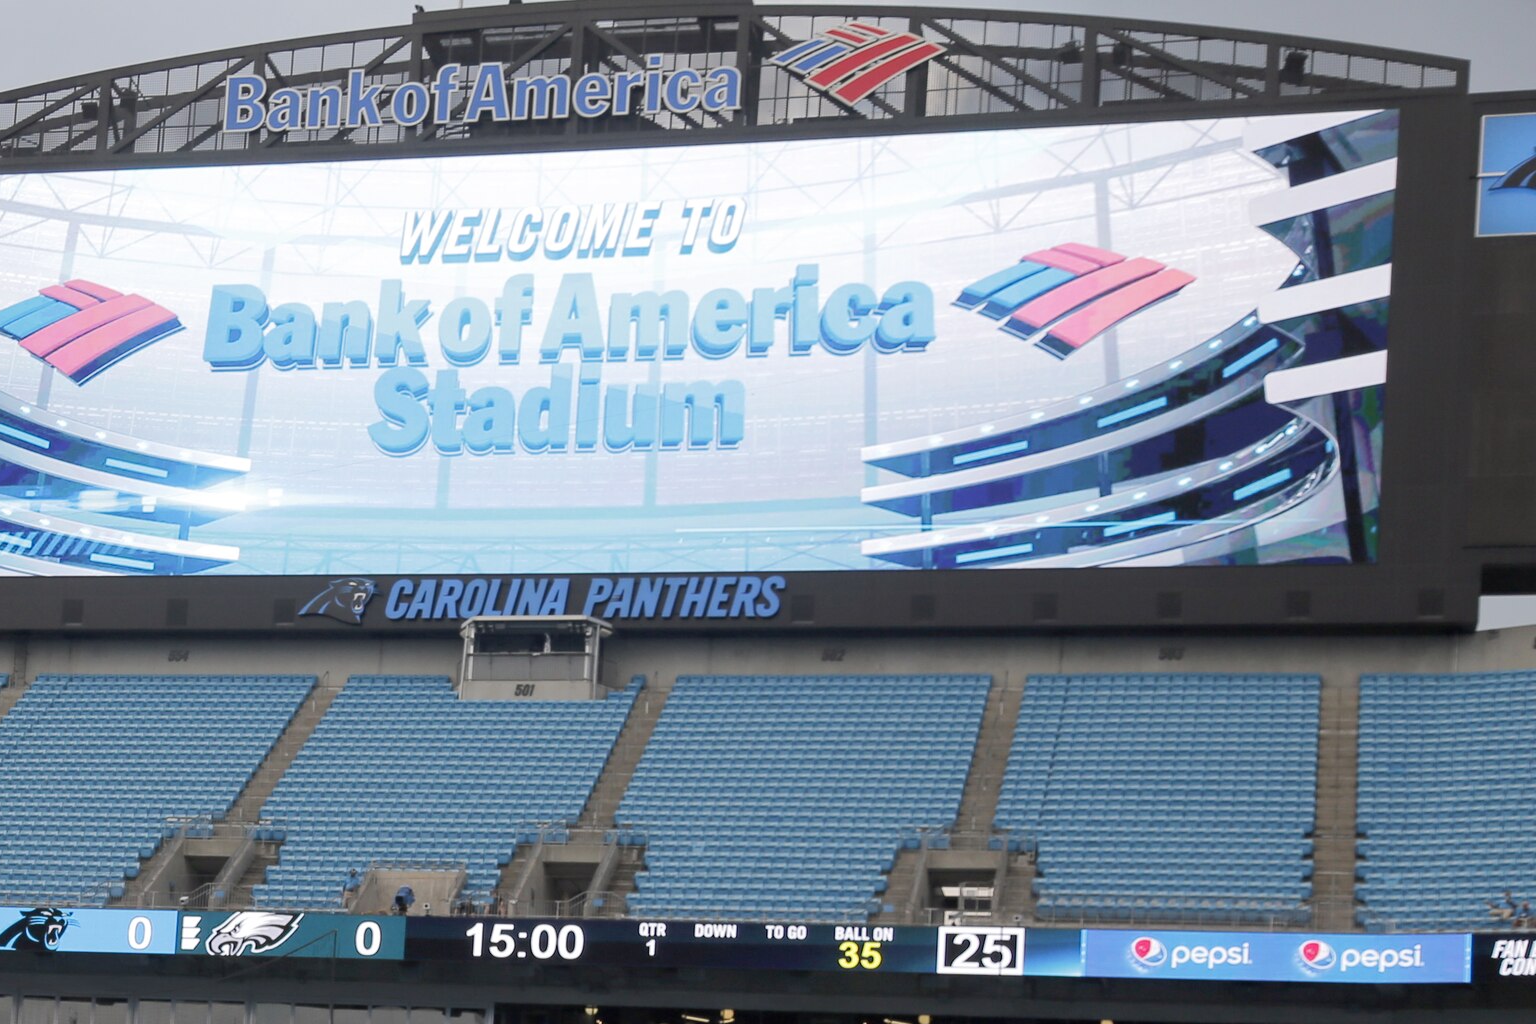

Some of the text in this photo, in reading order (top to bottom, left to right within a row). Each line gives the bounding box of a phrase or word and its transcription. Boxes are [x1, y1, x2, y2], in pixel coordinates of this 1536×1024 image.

[222, 54, 743, 134] Bank of America
[399, 196, 748, 265] WELCOME TO
[202, 262, 936, 372] Bank of America
[367, 362, 747, 458] Stadium
[383, 575, 788, 621] CAROLINA PANTHERS
[514, 684, 535, 697] 501
[127, 917, 153, 950] 0
[354, 922, 381, 957] 0
[465, 922, 585, 960] 15:00
[638, 922, 894, 942] QTR DOWN TO GO BALL ON
[645, 938, 656, 957] 1
[1491, 939, 1528, 958] FAN
[837, 941, 882, 969] 35
[949, 932, 1014, 970] 25
[1170, 943, 1250, 969] pepsi
[1340, 945, 1422, 973] pepsi
